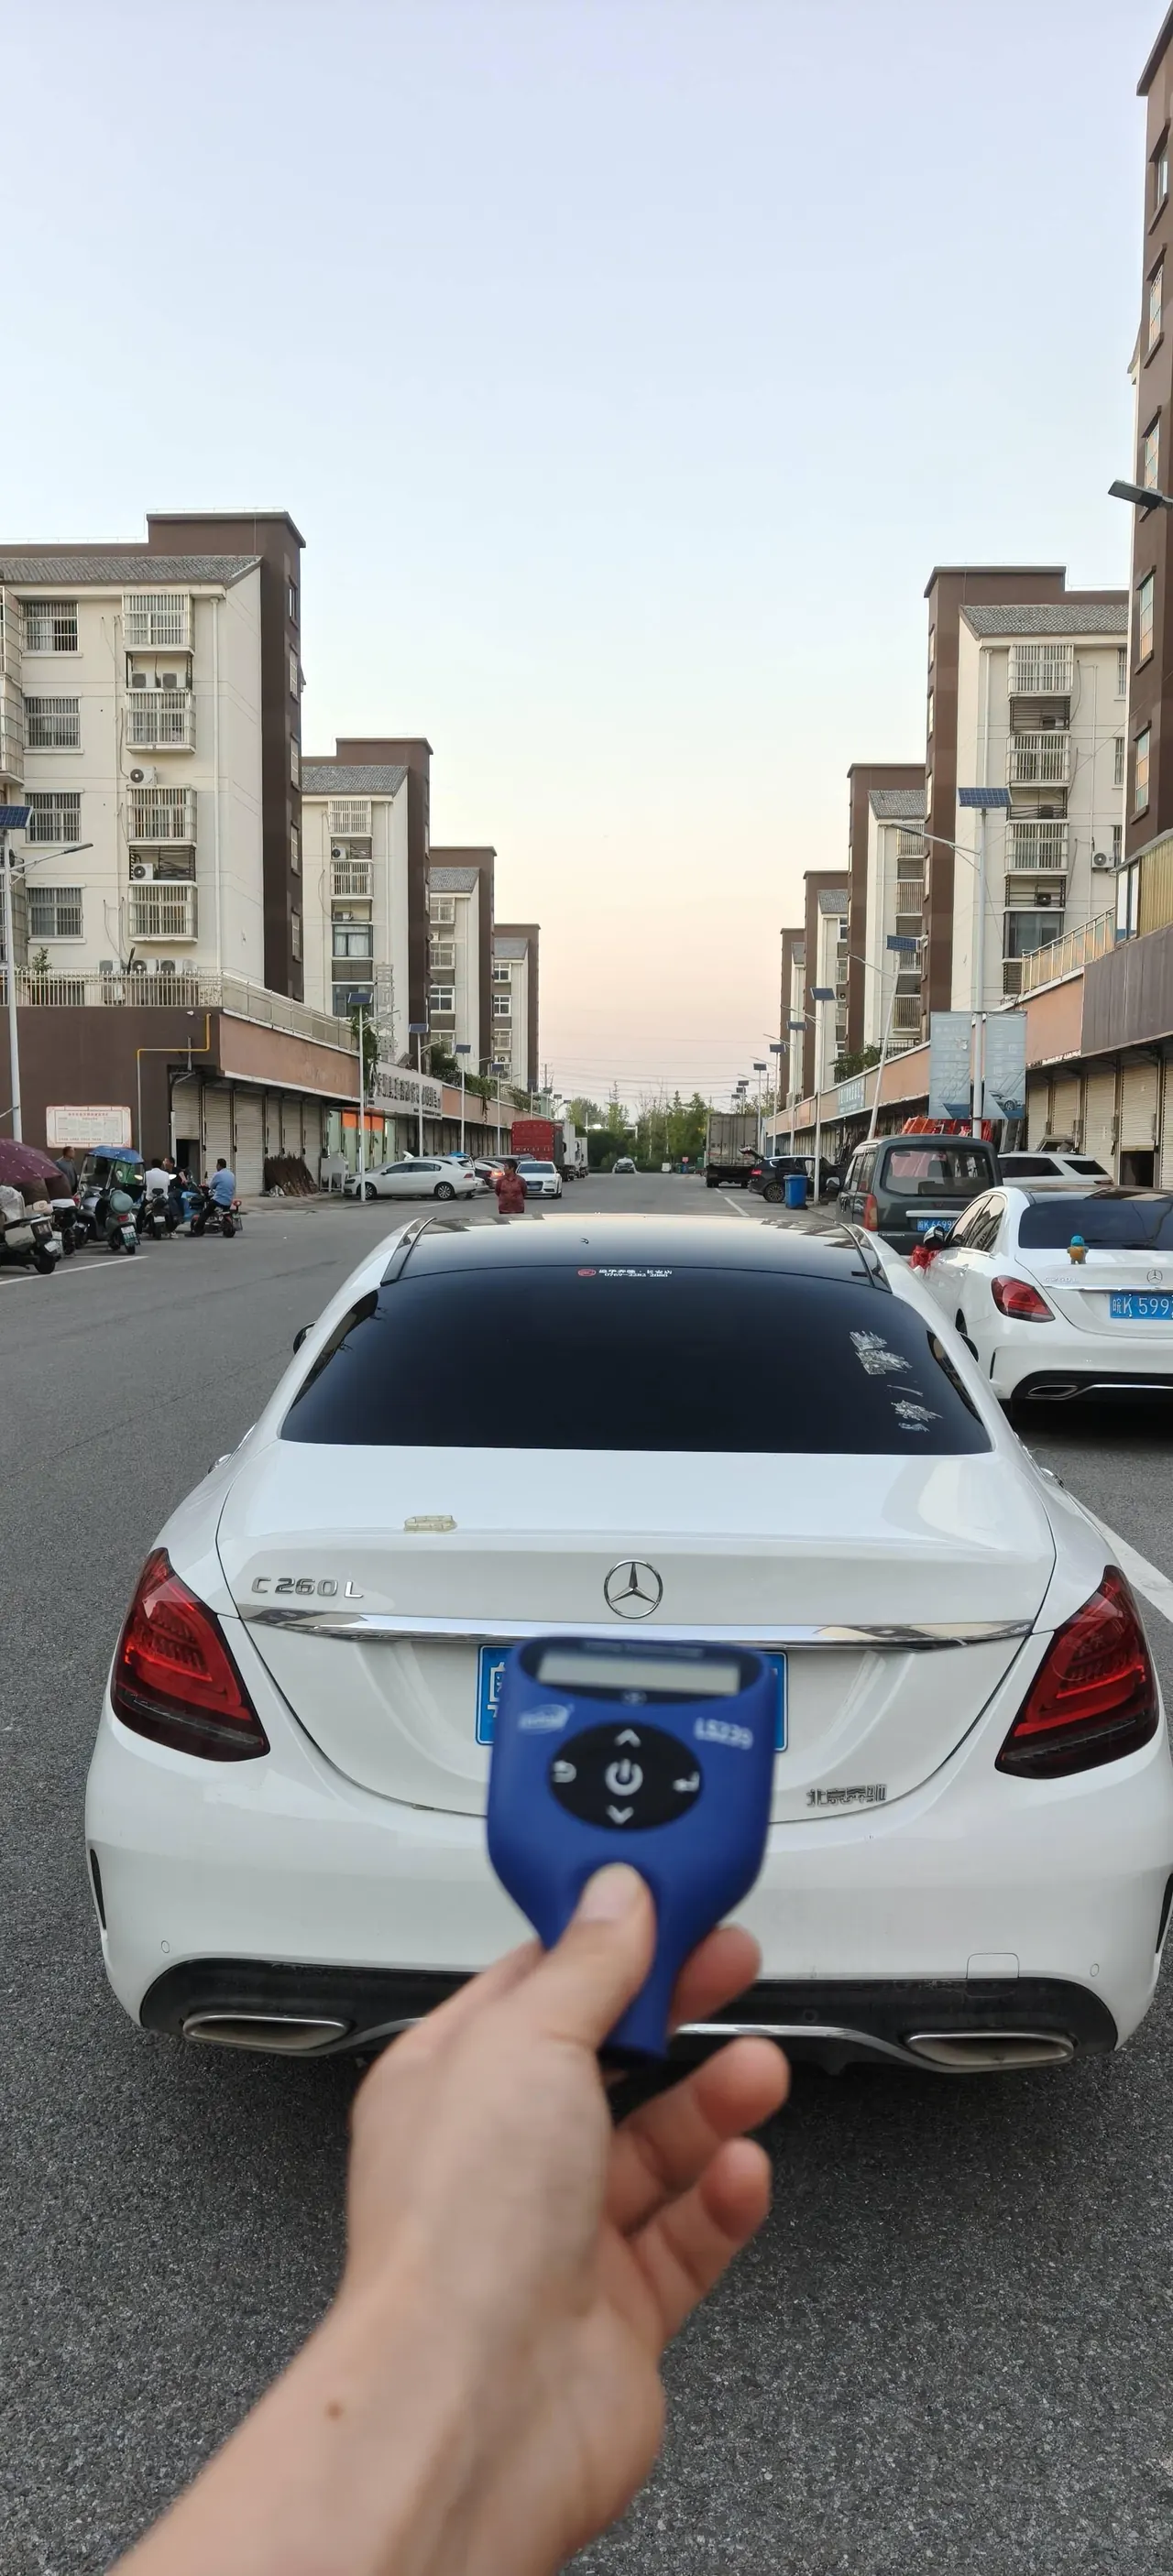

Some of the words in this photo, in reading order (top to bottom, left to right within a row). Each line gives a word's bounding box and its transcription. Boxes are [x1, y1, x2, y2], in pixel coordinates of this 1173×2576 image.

[251, 1576, 272, 1594] C
[274, 1577, 339, 1597] 260
[344, 1580, 364, 1599] L
[806, 1783, 887, 1807] 北京奔驰
